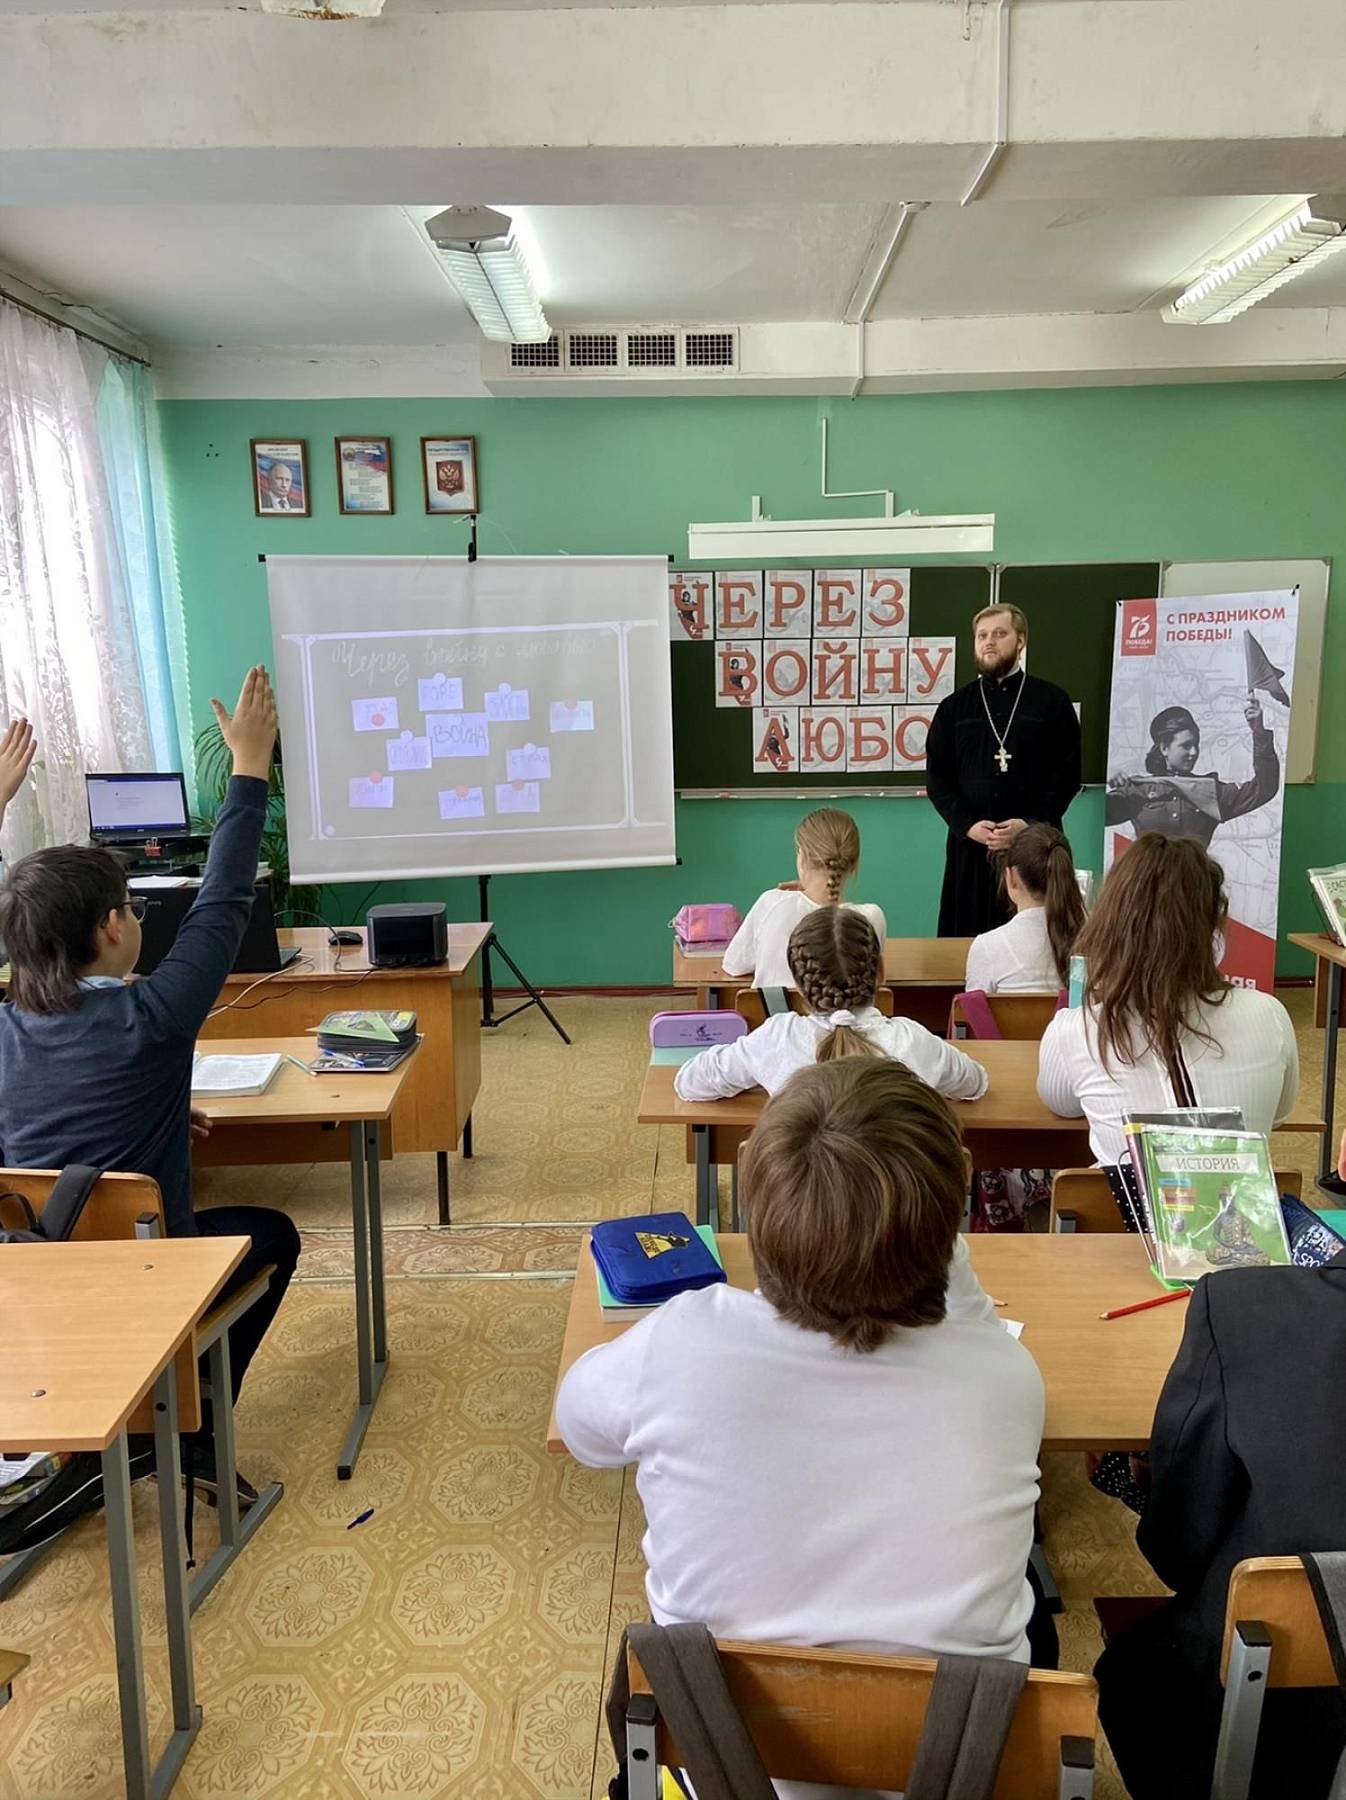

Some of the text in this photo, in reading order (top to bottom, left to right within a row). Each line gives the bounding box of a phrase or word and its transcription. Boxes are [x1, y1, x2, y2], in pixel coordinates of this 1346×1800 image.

[669, 578, 905, 632] ЧЕРЕЗ
[1166, 607, 1286, 625] С ПРАЗДНИКОМ
[1166, 628, 1233, 642] ПОБЕДЫ!
[718, 640, 953, 700] ВОЙНУ
[1176, 1157, 1240, 1170] ИСТОРИЯ
